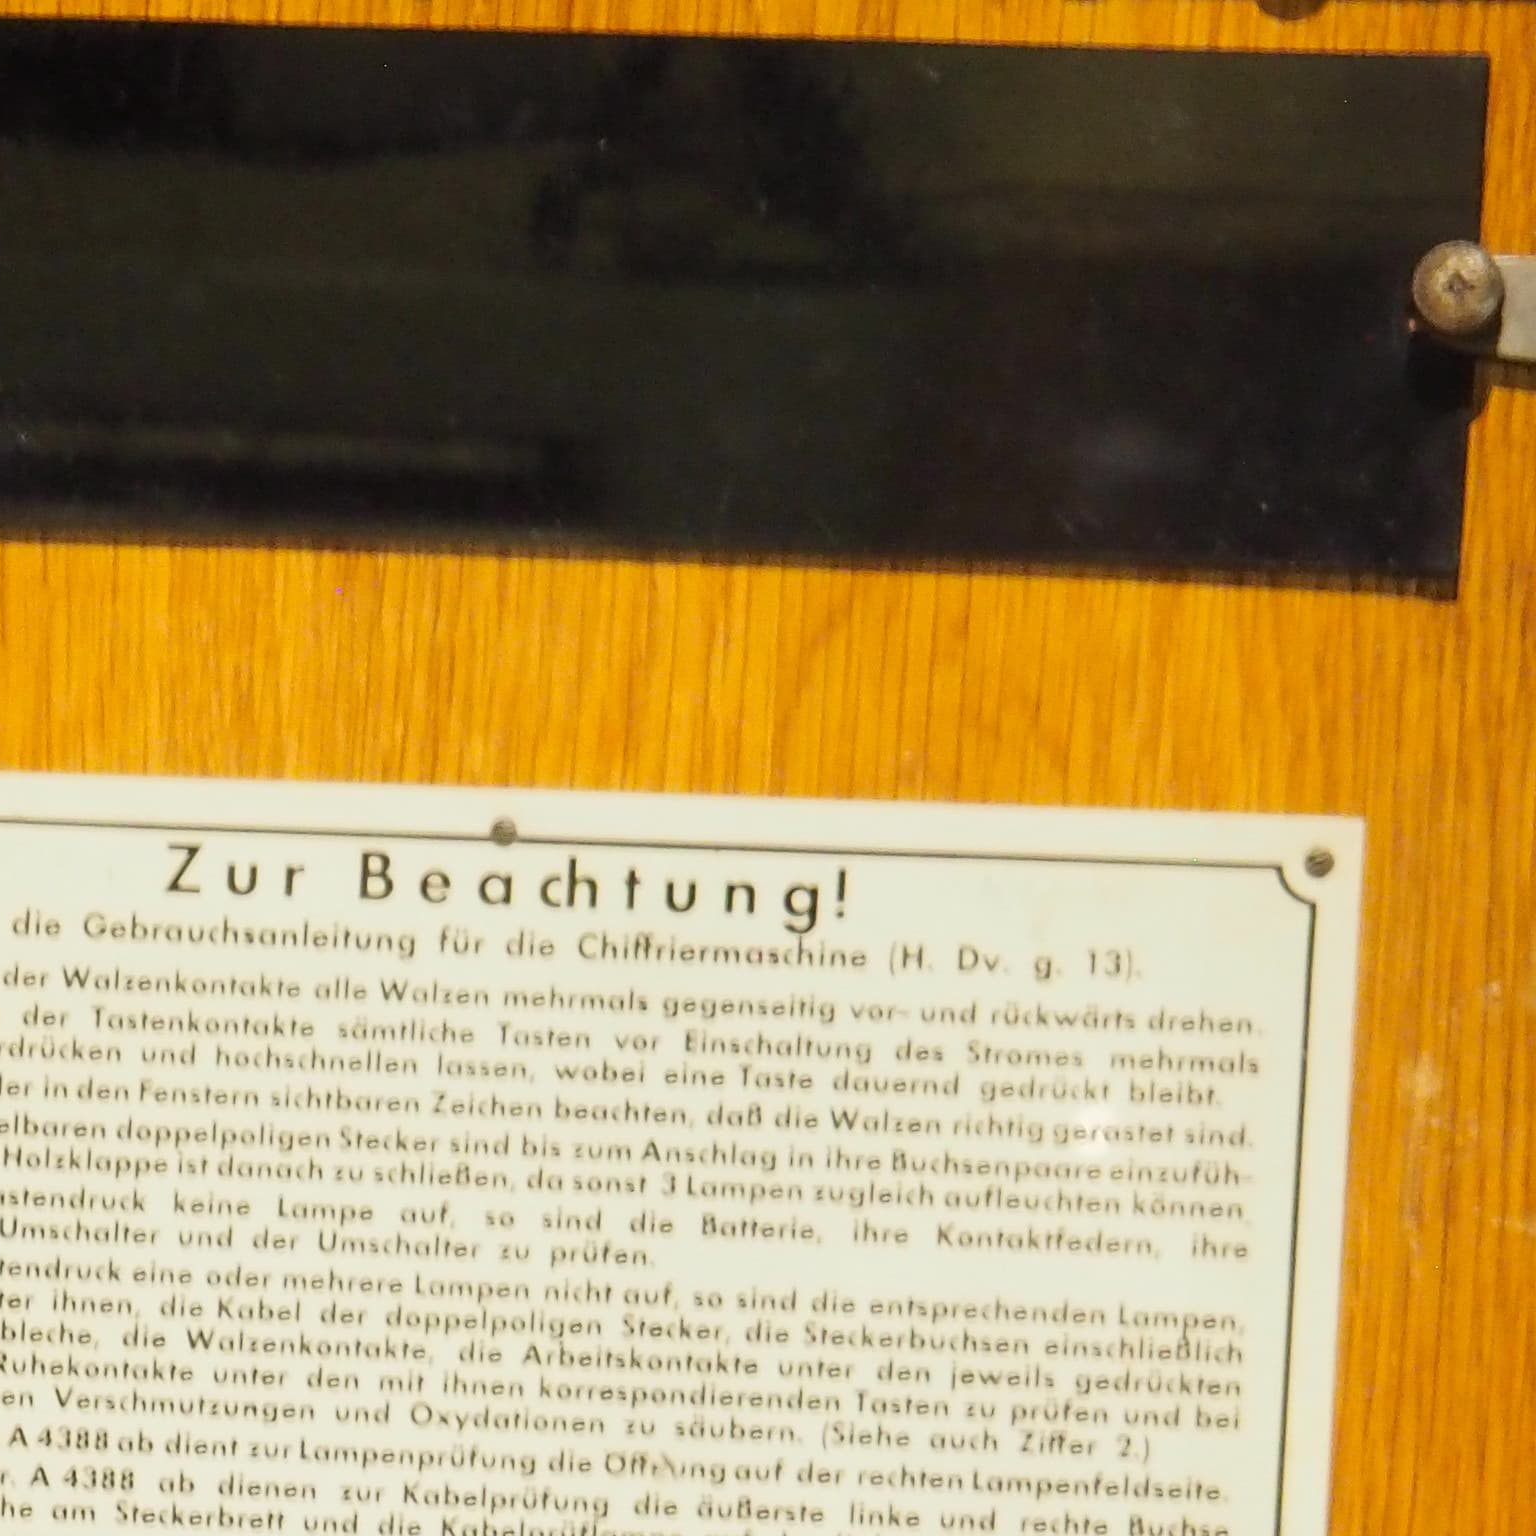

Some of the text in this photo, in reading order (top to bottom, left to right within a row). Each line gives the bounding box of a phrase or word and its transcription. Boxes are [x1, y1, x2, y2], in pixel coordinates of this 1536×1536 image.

[163, 840, 849, 936] Zur Beachtung!
[9, 905, 62, 938] die
[80, 910, 417, 961] Gebrauchsanleitung
[437, 923, 485, 956] für
[503, 927, 556, 959] die
[575, 933, 868, 969] Chiffriermaschine
[0, 961, 50, 989] der
[60, 963, 302, 1000] Walzenkontakte
[312, 974, 368, 1002] alle
[378, 977, 490, 1007] Walzen
[501, 983, 650, 1014] mehrmals
[660, 993, 837, 1026] gegenseitig
[918, 1000, 978, 1026] und
[989, 1001, 1137, 1031] rückwärts
[20, 1000, 69, 1029] der
[90, 1003, 316, 1039] Tastenkontakte
[336, 1016, 475, 1045] sämtliche
[497, 1020, 592, 1050] Tasten
[613, 1032, 660, 1053] vor
[682, 1027, 873, 1066] Einschaltung
[893, 1036, 945, 1064] des
[965, 1037, 1084, 1069] Stromes
[1108, 1044, 1260, 1076] mehrmals
[139, 1040, 197, 1067] und
[213, 1042, 419, 1076] hochschnellen
[552, 1056, 646, 1085] wobei
[662, 1060, 726, 1088] eine
[737, 1061, 814, 1091] Taste
[830, 1066, 961, 1098] dauernd
[978, 1074, 1110, 1104] gedrückt
[41, 1073, 69, 1100] in
[74, 1074, 130, 1103] den
[137, 1076, 260, 1108] Fenstern
[269, 1083, 421, 1114] sichtbaren
[430, 1089, 543, 1120] Zeichen
[704, 1100, 764, 1128] daß
[772, 1103, 820, 1131] die
[828, 1105, 942, 1136] Walzen
[951, 1111, 1045, 1145] richtig
[171, 1187, 252, 1218] keine
[275, 1192, 375, 1225] Lampe
[483, 1209, 516, 1229] so
[540, 1205, 603, 1233] sind
[627, 1208, 675, 1235] die
[851, 1217, 910, 1246] ihre
[1189, 1231, 1249, 1260] ihre
[176, 1222, 234, 1250] und
[250, 1224, 299, 1252] der
[316, 1225, 481, 1260] Umschalter
[498, 1242, 531, 1262] zu
[27, 1461, 51, 1489] A
[60, 1463, 136, 1494] 4388
[156, 1467, 197, 1496] ab
[215, 1470, 317, 1501] dienen
[339, 1484, 385, 1504] zur
[400, 1480, 610, 1521] Kabelprüfung
[631, 1490, 679, 1518] die
[694, 1493, 826, 1525] äußerste
[847, 1499, 921, 1529] linke
[938, 1506, 998, 1533] und
[1018, 1509, 1109, 1536] rechte
